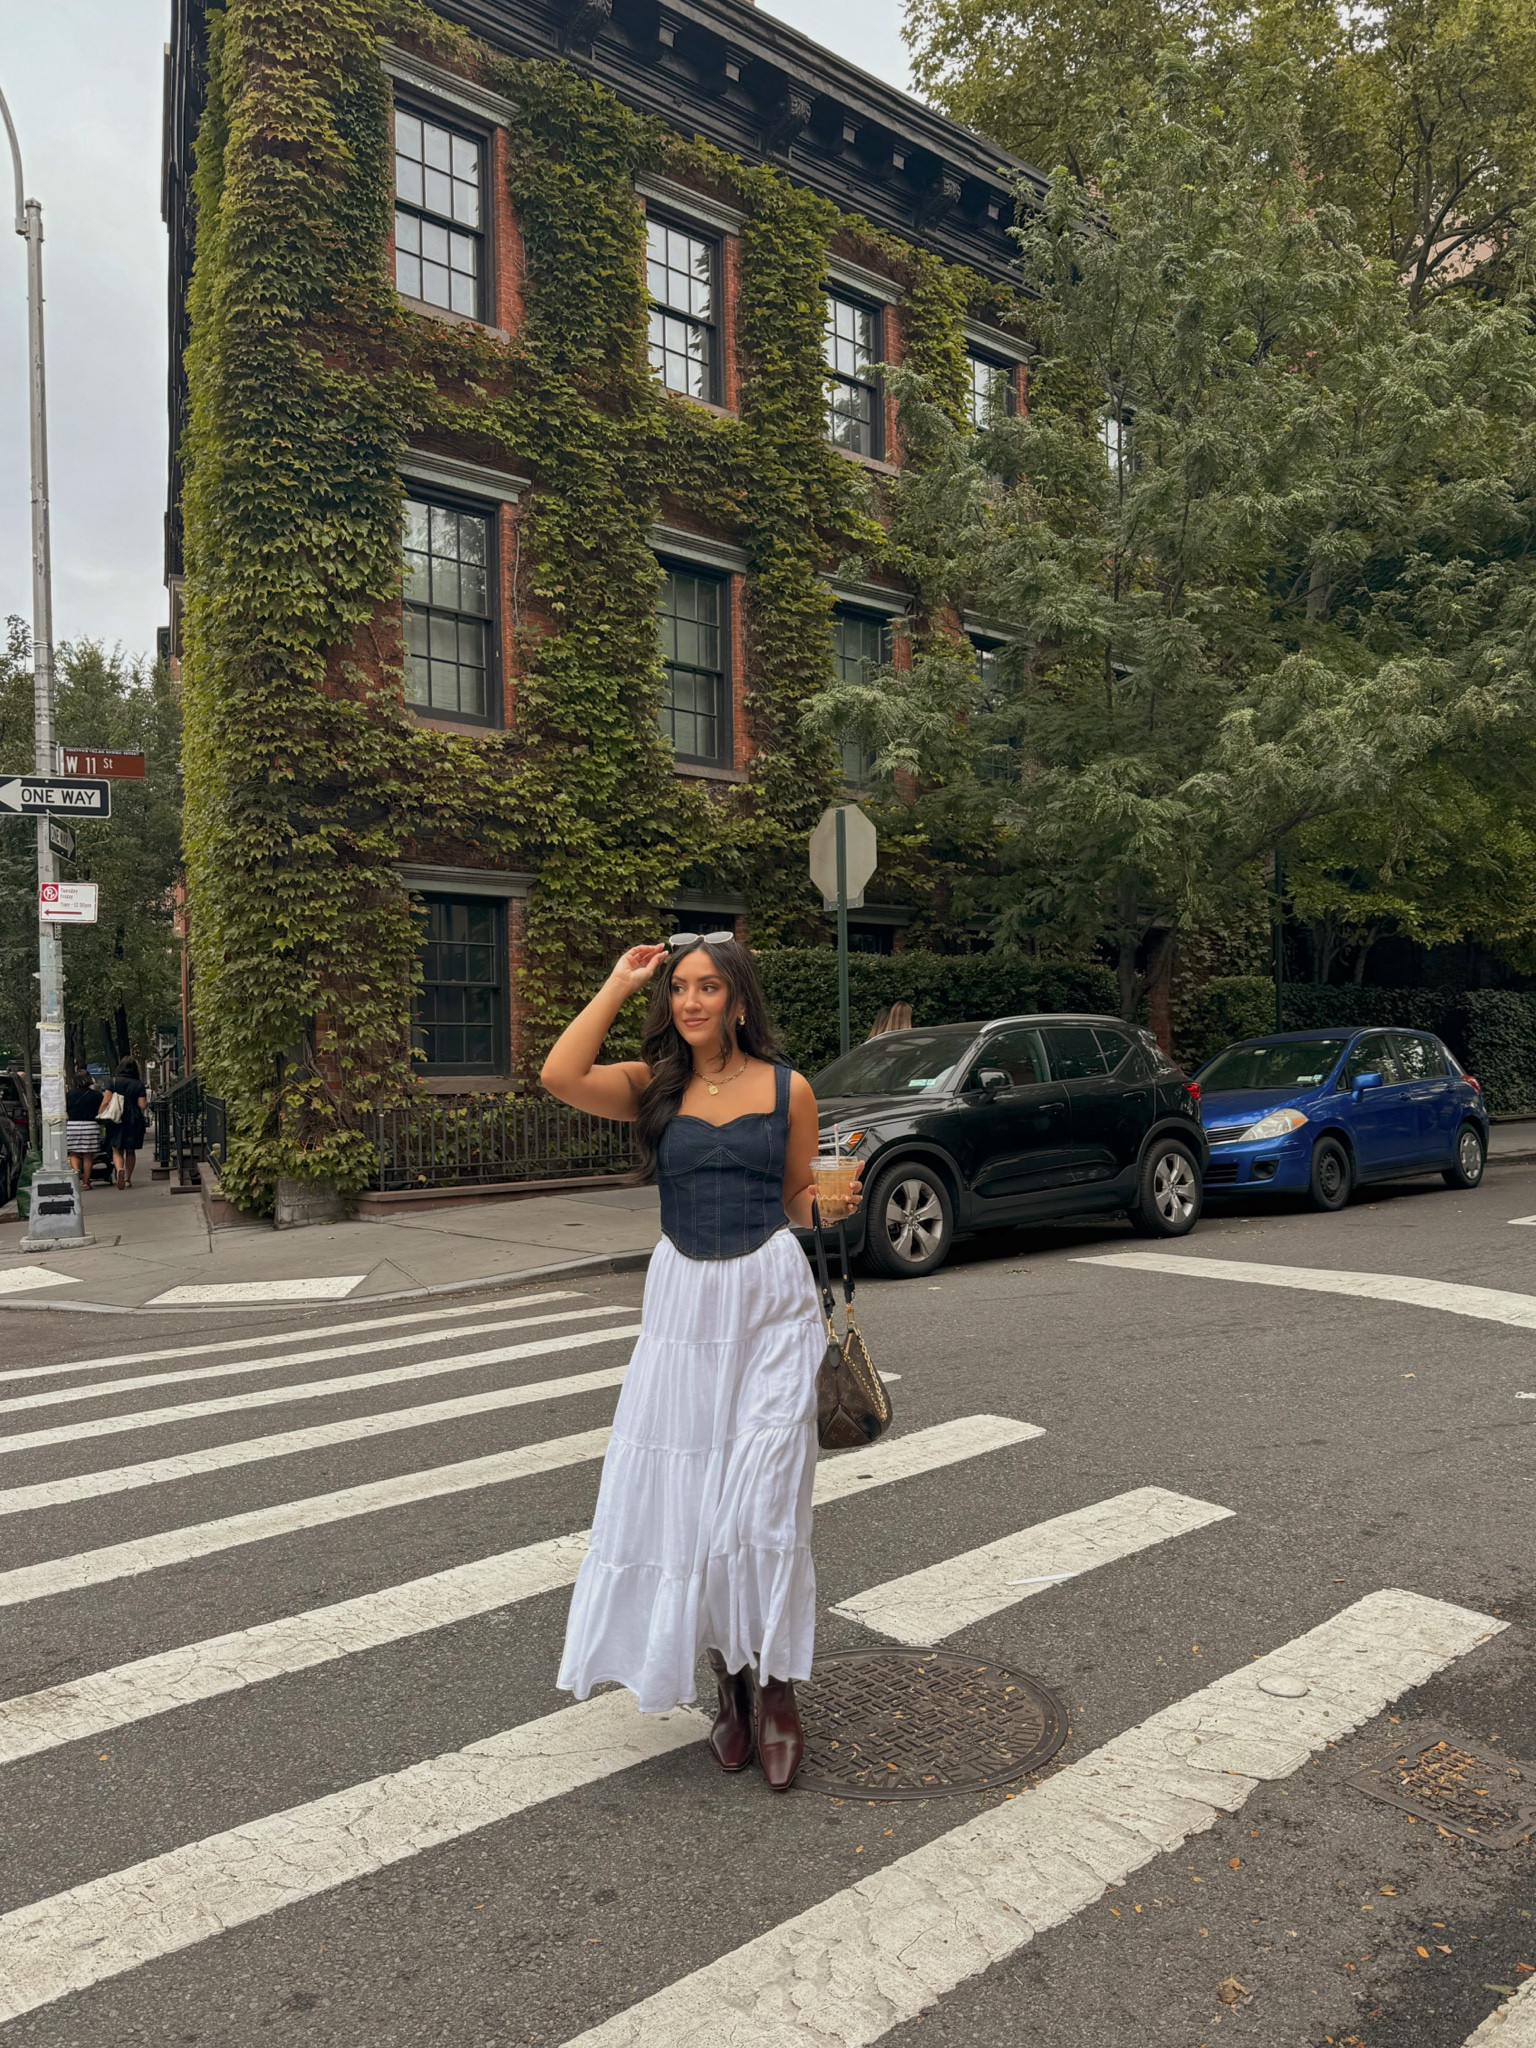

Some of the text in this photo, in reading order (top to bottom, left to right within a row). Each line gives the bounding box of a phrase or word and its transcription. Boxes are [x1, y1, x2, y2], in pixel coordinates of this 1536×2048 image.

[66, 755, 113, 774] W 11 St
[21, 788, 96, 805] ONE WAY
[51, 825, 60, 844] ONE
